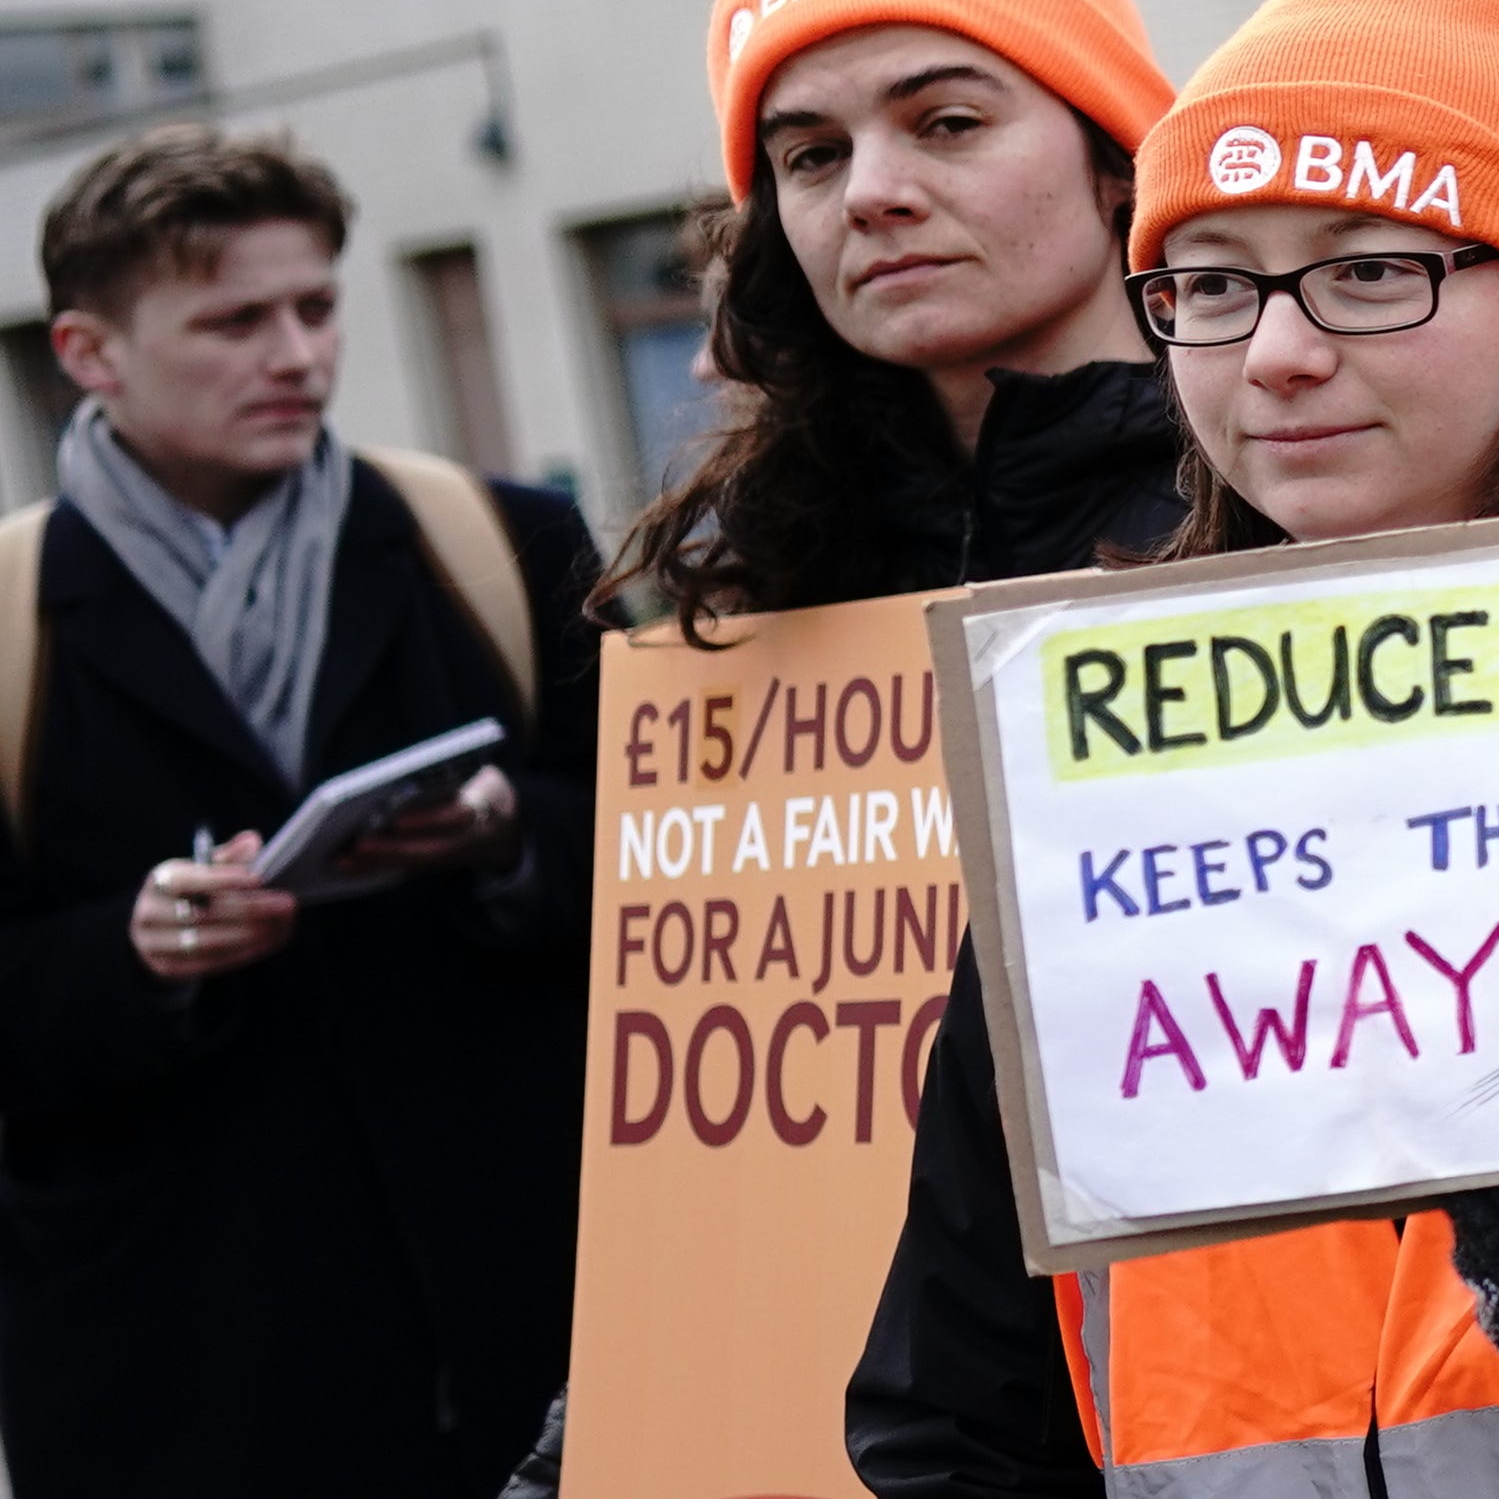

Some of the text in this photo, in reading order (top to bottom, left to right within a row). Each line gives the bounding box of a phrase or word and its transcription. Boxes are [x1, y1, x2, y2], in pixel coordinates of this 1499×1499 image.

[1293, 134, 1462, 228] BMA
[625, 669, 935, 790] £15/HOU
[618, 803, 725, 882] NOT
[732, 801, 771, 873] A
[783, 788, 900, 871] FAIR
[1080, 828, 1334, 921] KEEPS
[616, 882, 961, 996] FOR A JUNI
